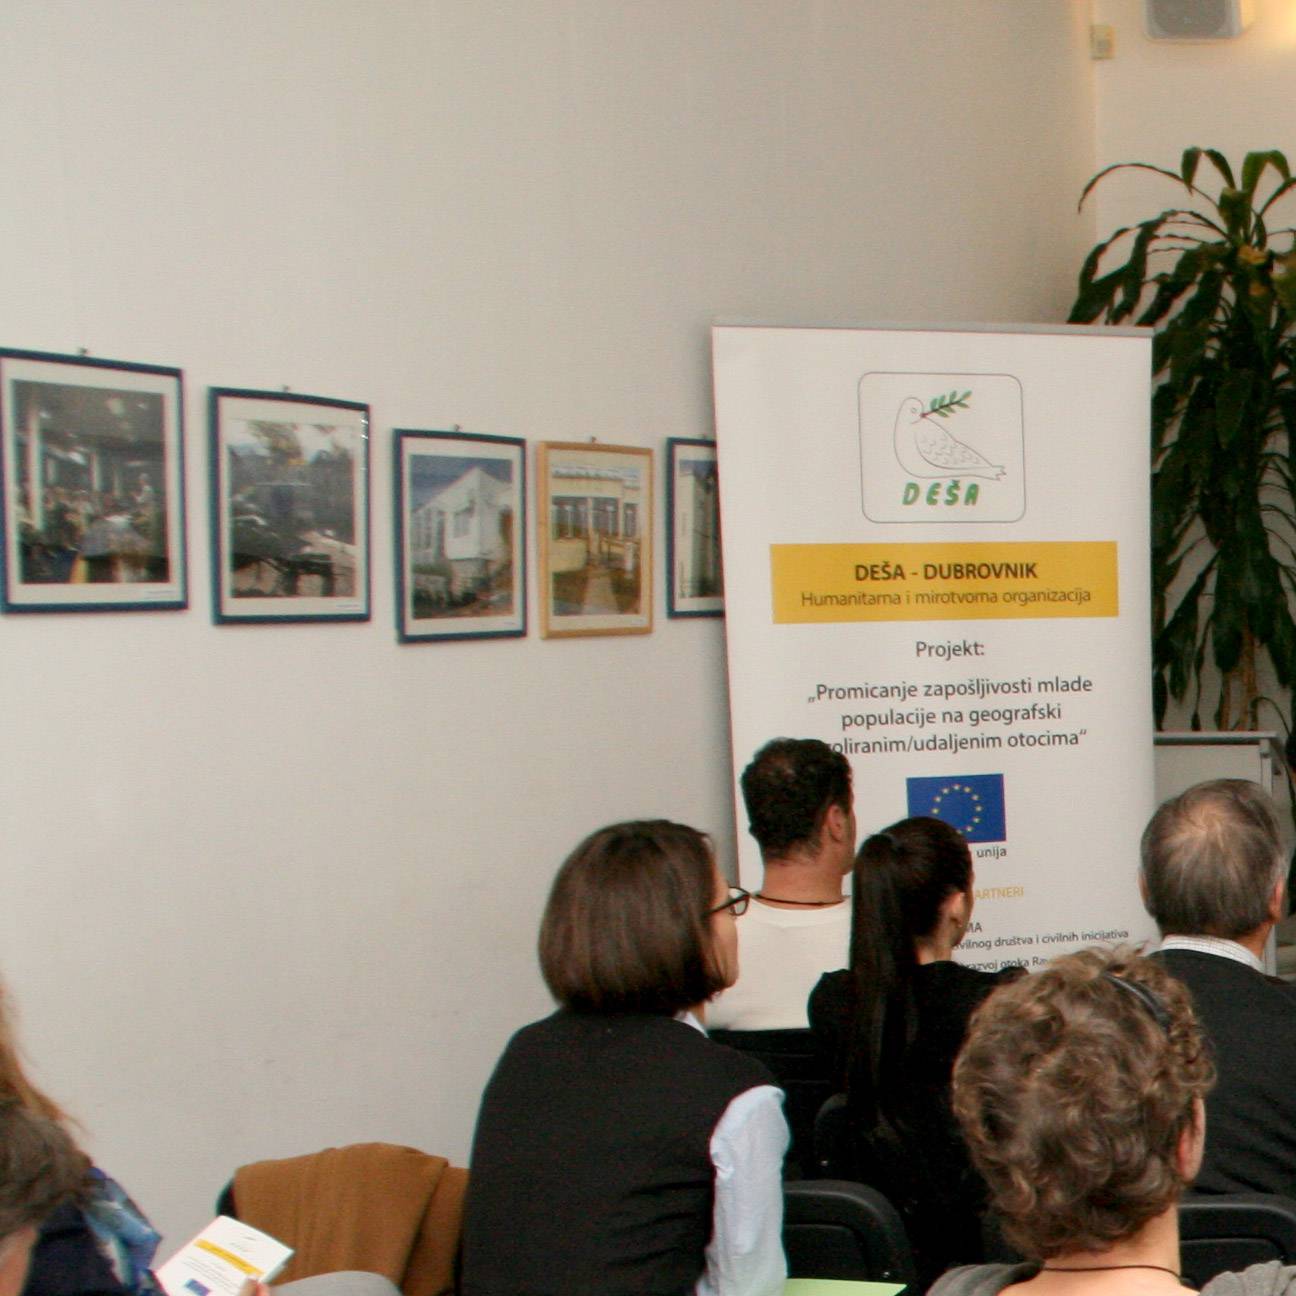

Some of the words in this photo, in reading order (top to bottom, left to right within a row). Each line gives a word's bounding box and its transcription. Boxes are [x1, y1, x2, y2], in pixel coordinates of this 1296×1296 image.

[901, 480, 980, 506] DEŠA
[855, 561, 906, 581] DEŠA
[923, 562, 1038, 580] DUBROVNIK
[801, 590, 901, 607] Humanitarna
[905, 589, 910, 604] i
[915, 588, 998, 605] mirotvorna
[1002, 587, 1092, 607] organizacija
[915, 640, 985, 662] Projekt:
[808, 682, 918, 704] „Promicanje
[923, 677, 1032, 700] zapošljivosti
[1037, 675, 1093, 694] mlade
[841, 707, 936, 731] populacije
[942, 711, 964, 725] na
[969, 703, 1062, 726] geografski
[828, 735, 1001, 755] oliranim/udaljenim
[976, 846, 1007, 860] unija
[975, 886, 1024, 899] ARTNERI
[1036, 934, 1040, 944] i
[1042, 931, 1079, 944] civilnih
[1081, 929, 1129, 943] inicijativa
